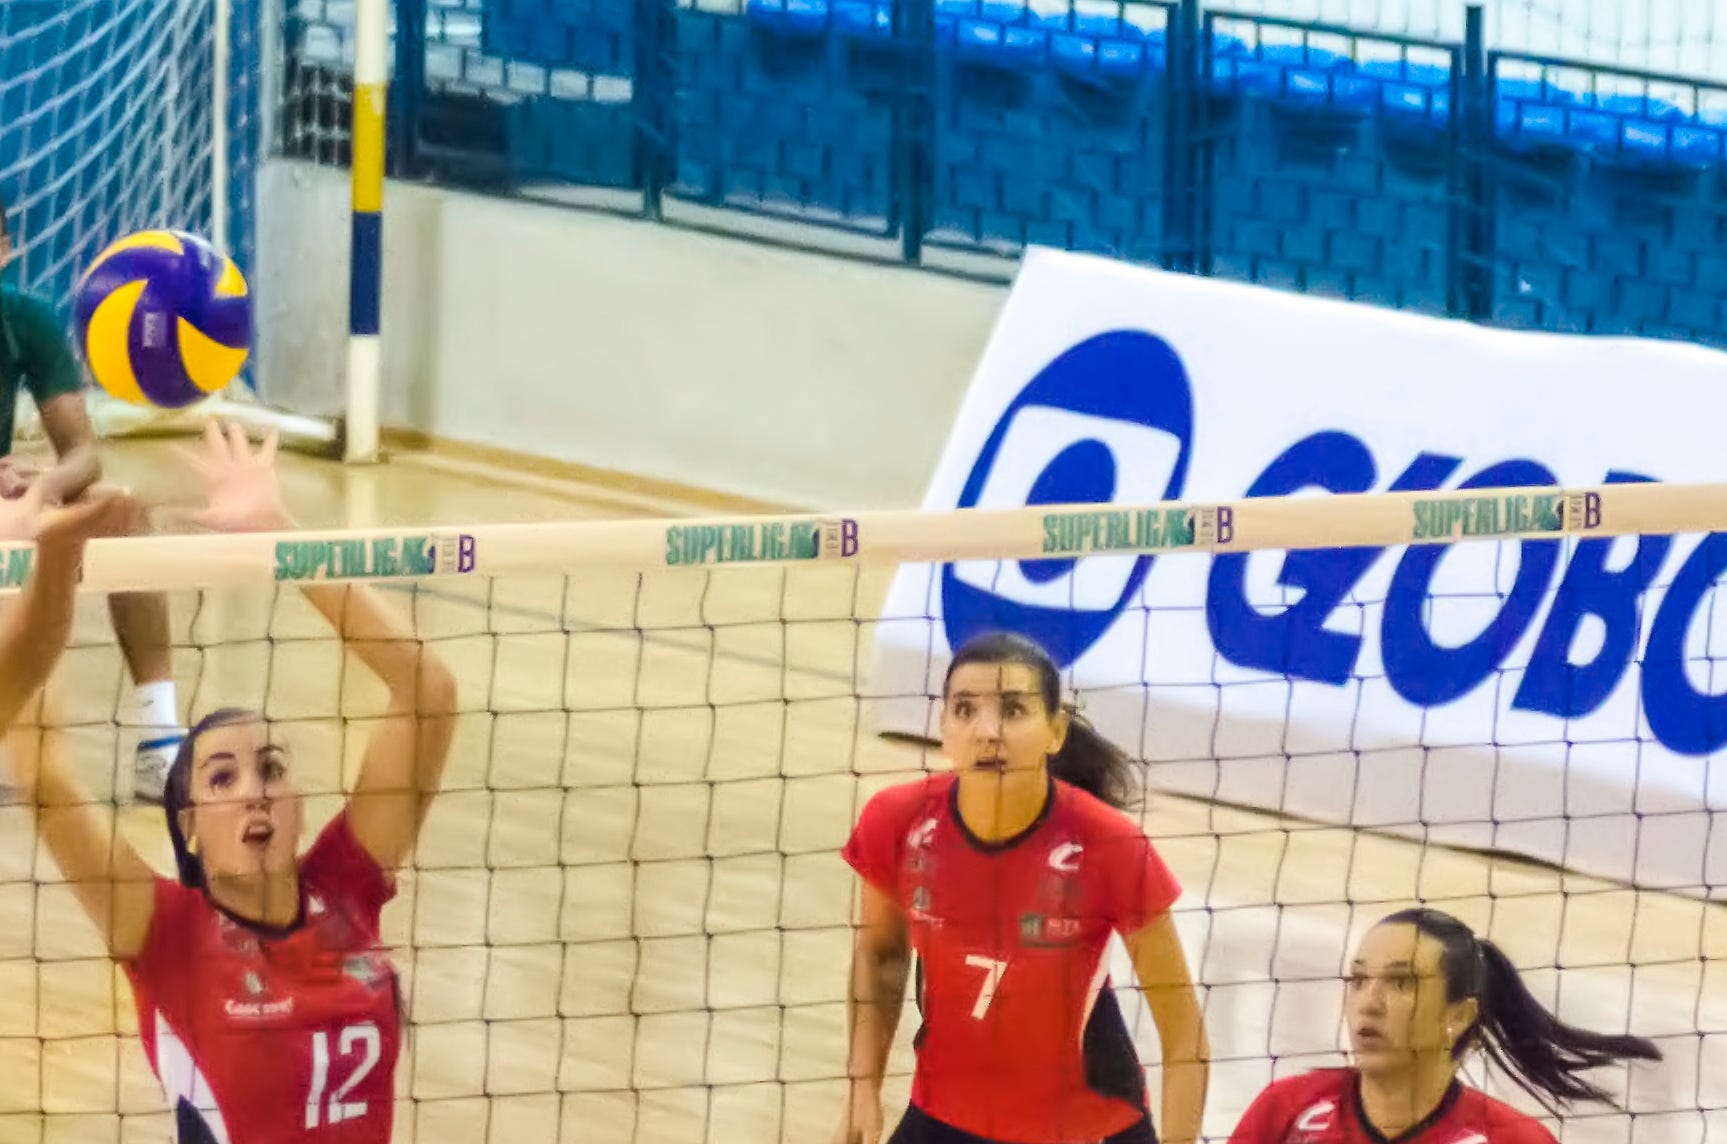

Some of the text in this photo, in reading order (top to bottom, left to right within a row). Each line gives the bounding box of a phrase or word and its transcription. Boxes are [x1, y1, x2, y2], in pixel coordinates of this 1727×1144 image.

[1043, 508, 1195, 552] SUPERLIGA
[1217, 506, 1233, 543] B
[1413, 494, 1564, 539] SUPERLIGA
[1584, 492, 1601, 529] B
[275, 536, 436, 580] SUPERLIGA
[458, 535, 475, 573] B
[666, 520, 820, 566] SUPERLIGA
[841, 519, 859, 557] B
[964, 955, 1008, 1021] 7
[304, 1025, 382, 1130] 12
